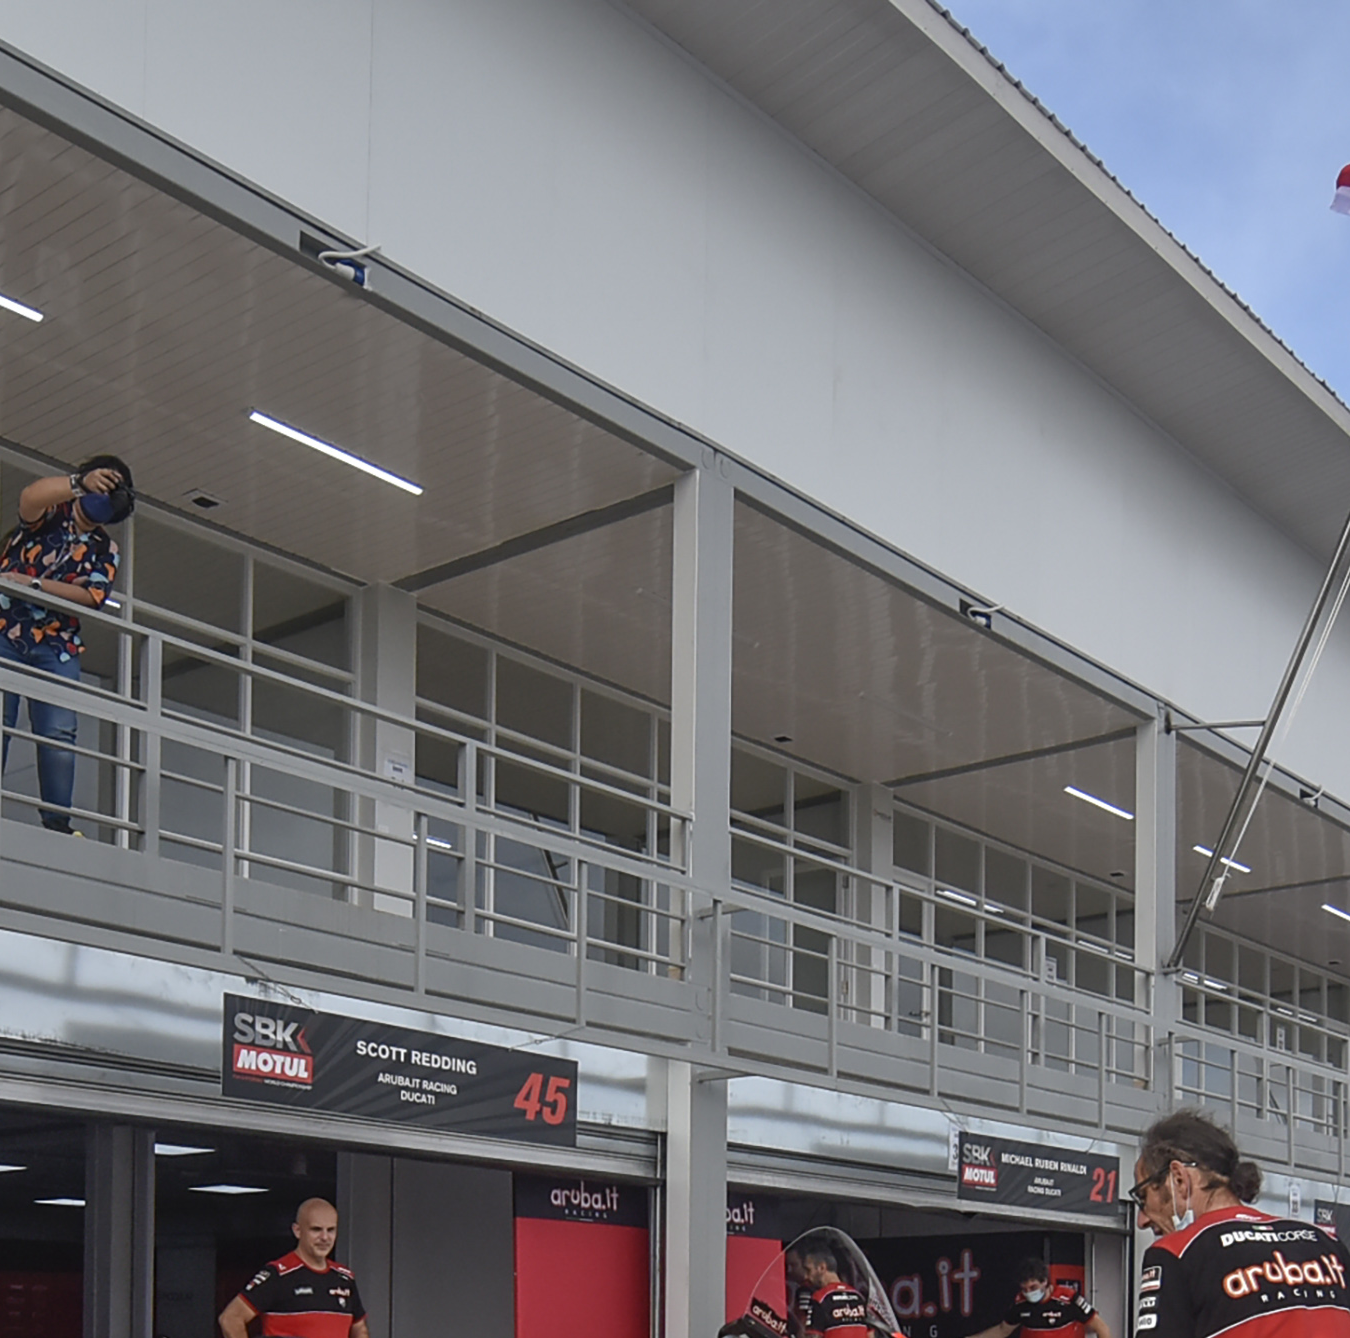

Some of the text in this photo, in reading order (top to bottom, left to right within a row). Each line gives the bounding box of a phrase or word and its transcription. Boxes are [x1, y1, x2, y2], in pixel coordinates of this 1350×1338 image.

[233, 1012, 299, 1053] SBK
[237, 1049, 308, 1078] MOTUL
[356, 1041, 478, 1075] SCOTT REDDING
[400, 1090, 436, 1105] DUCATI
[427, 1081, 458, 1095] RACING
[514, 1072, 571, 1126] 45
[962, 1142, 991, 1167] SBK
[1001, 1152, 1087, 1175] MICHAEL RUBEN RINALDI
[963, 1165, 996, 1184] MOTUL
[1089, 1167, 1117, 1204] 21
[550, 1180, 620, 1212] aruba.it
[1223, 1250, 1347, 1298] aruba.it
[1260, 1288, 1337, 1302] RACING
